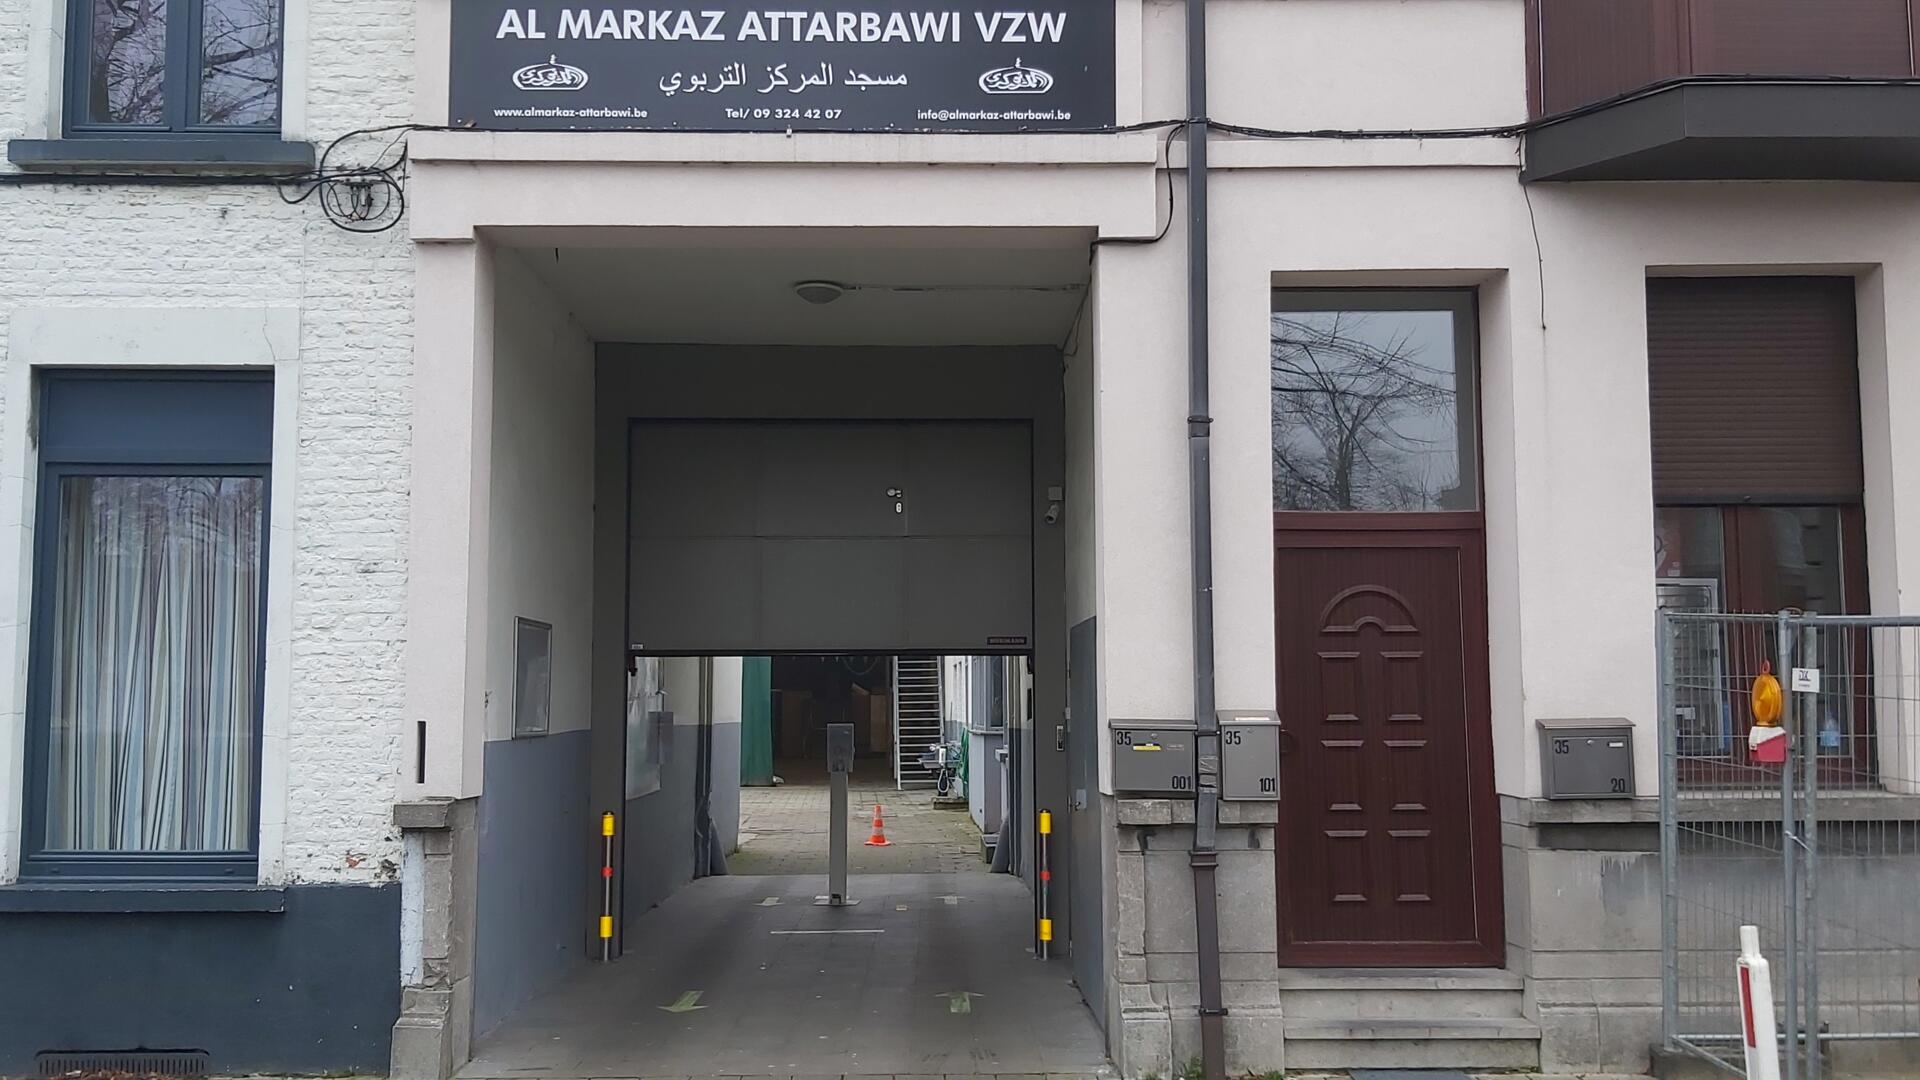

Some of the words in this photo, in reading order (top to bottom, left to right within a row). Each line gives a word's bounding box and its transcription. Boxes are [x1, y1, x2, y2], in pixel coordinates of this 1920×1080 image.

[496, 9, 546, 39] AL
[557, 9, 726, 41] MARKAZ
[737, 11, 960, 42] ATTARBAWI
[974, 12, 1067, 43] VZW
[659, 62, 747, 96] التربوي
[757, 62, 834, 93] المركز
[844, 69, 908, 92] مسجد
[494, 107, 648, 118] www.almarkaz-attarbawi.be
[725, 108, 749, 120] Tel/
[753, 109, 771, 119] 09
[775, 109, 800, 120] 324
[804, 109, 821, 119] 42
[825, 109, 842, 120] 07
[917, 109, 1071, 121] info@almarkaz-attarbawi.be
[1116, 731, 1132, 746] 35
[1225, 730, 1242, 745] 35
[1554, 740, 1569, 754] 35
[1171, 775, 1192, 790] 001
[1259, 777, 1276, 793] 101
[1610, 778, 1626, 793] 20
